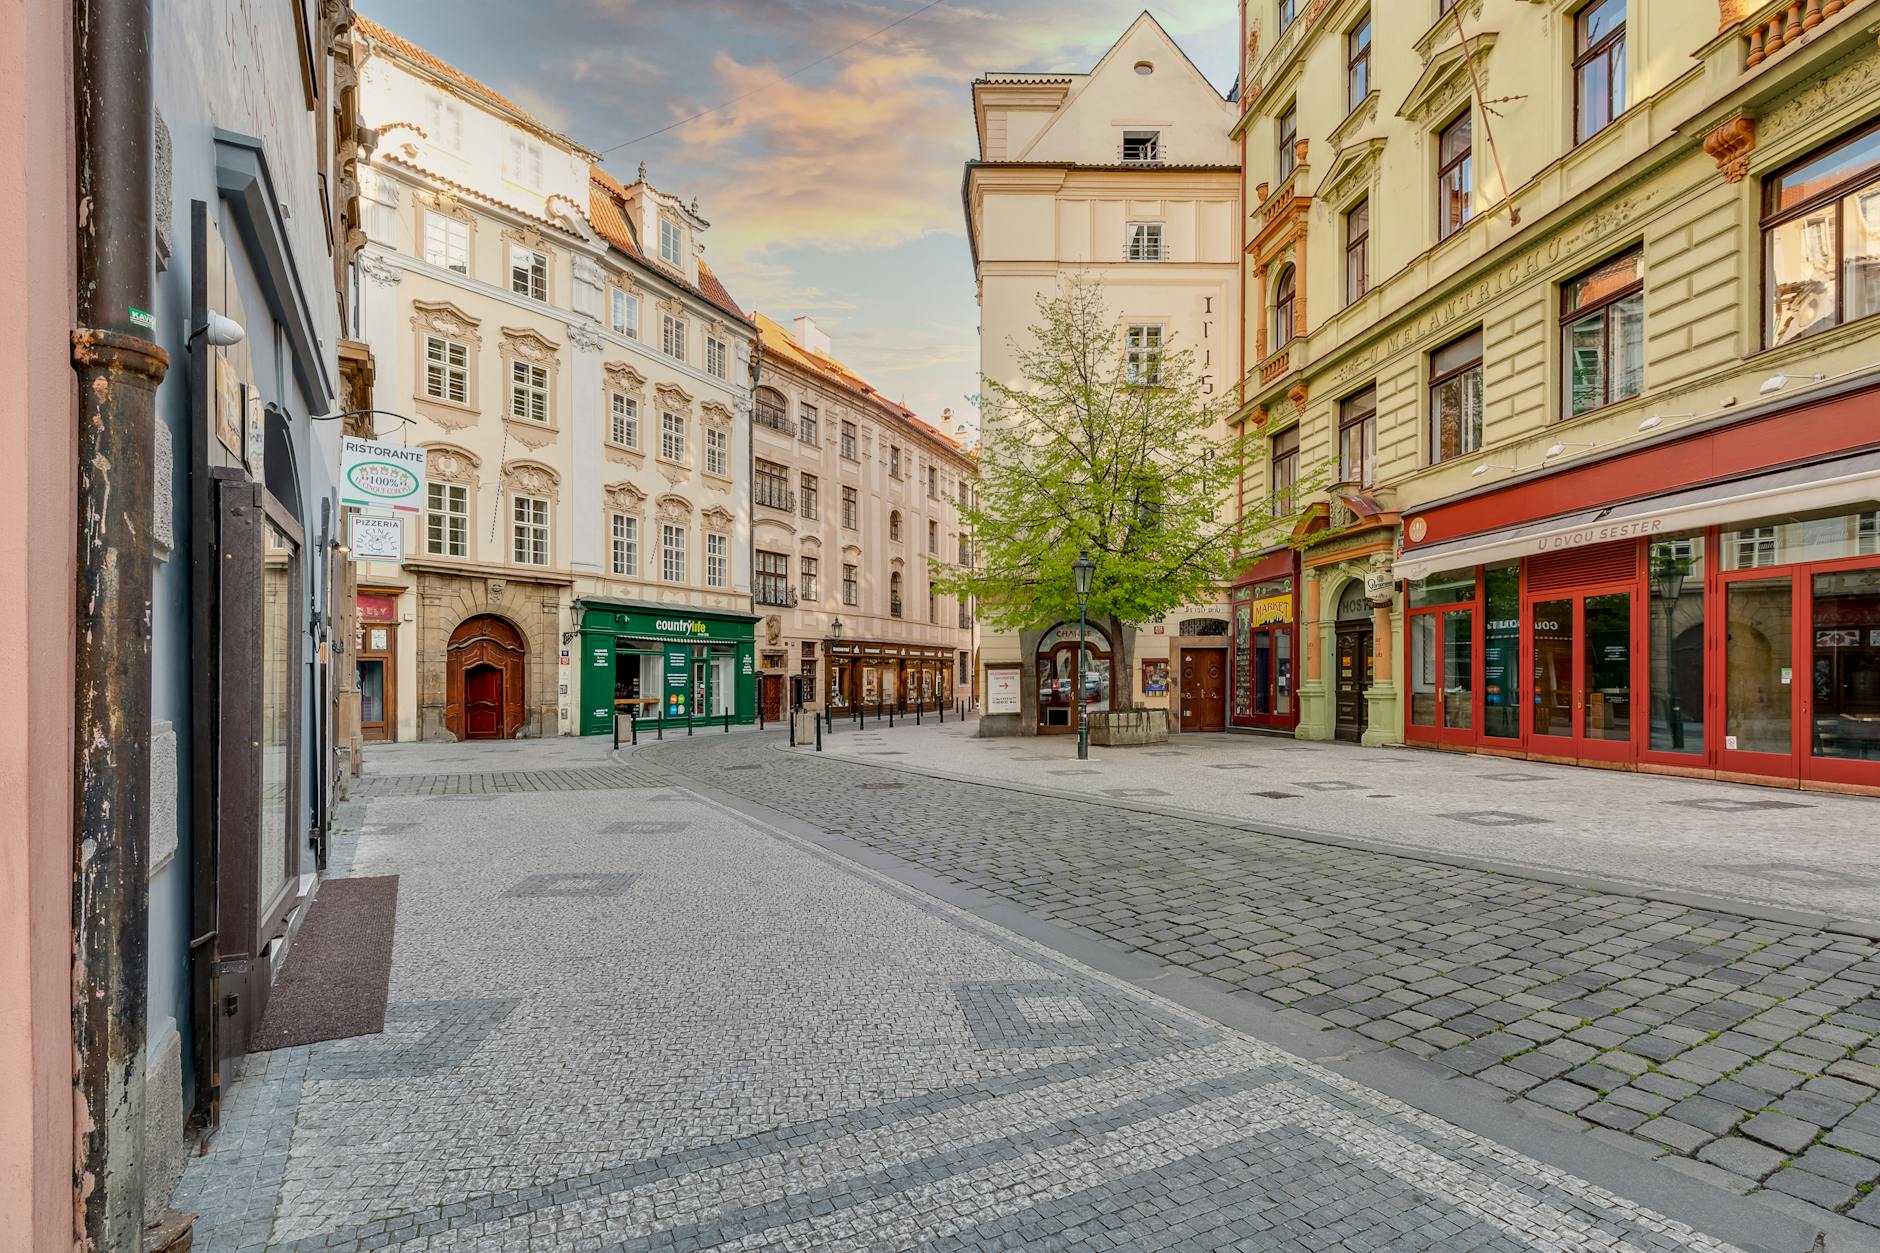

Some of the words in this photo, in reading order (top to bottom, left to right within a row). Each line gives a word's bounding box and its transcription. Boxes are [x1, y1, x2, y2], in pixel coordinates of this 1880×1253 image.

[1369, 345, 1379, 364] U
[1386, 236, 1562, 356] MELANTRICHŮ
[345, 442, 424, 462] RISTORANTE
[370, 476, 399, 488] 100%
[355, 518, 399, 528] PIZZERIA
[1538, 539, 1548, 550] U
[1554, 531, 1594, 547] DVOU
[1600, 519, 1662, 538] SESTER
[1255, 601, 1290, 618] MARKET
[1341, 599, 1369, 613] HOST
